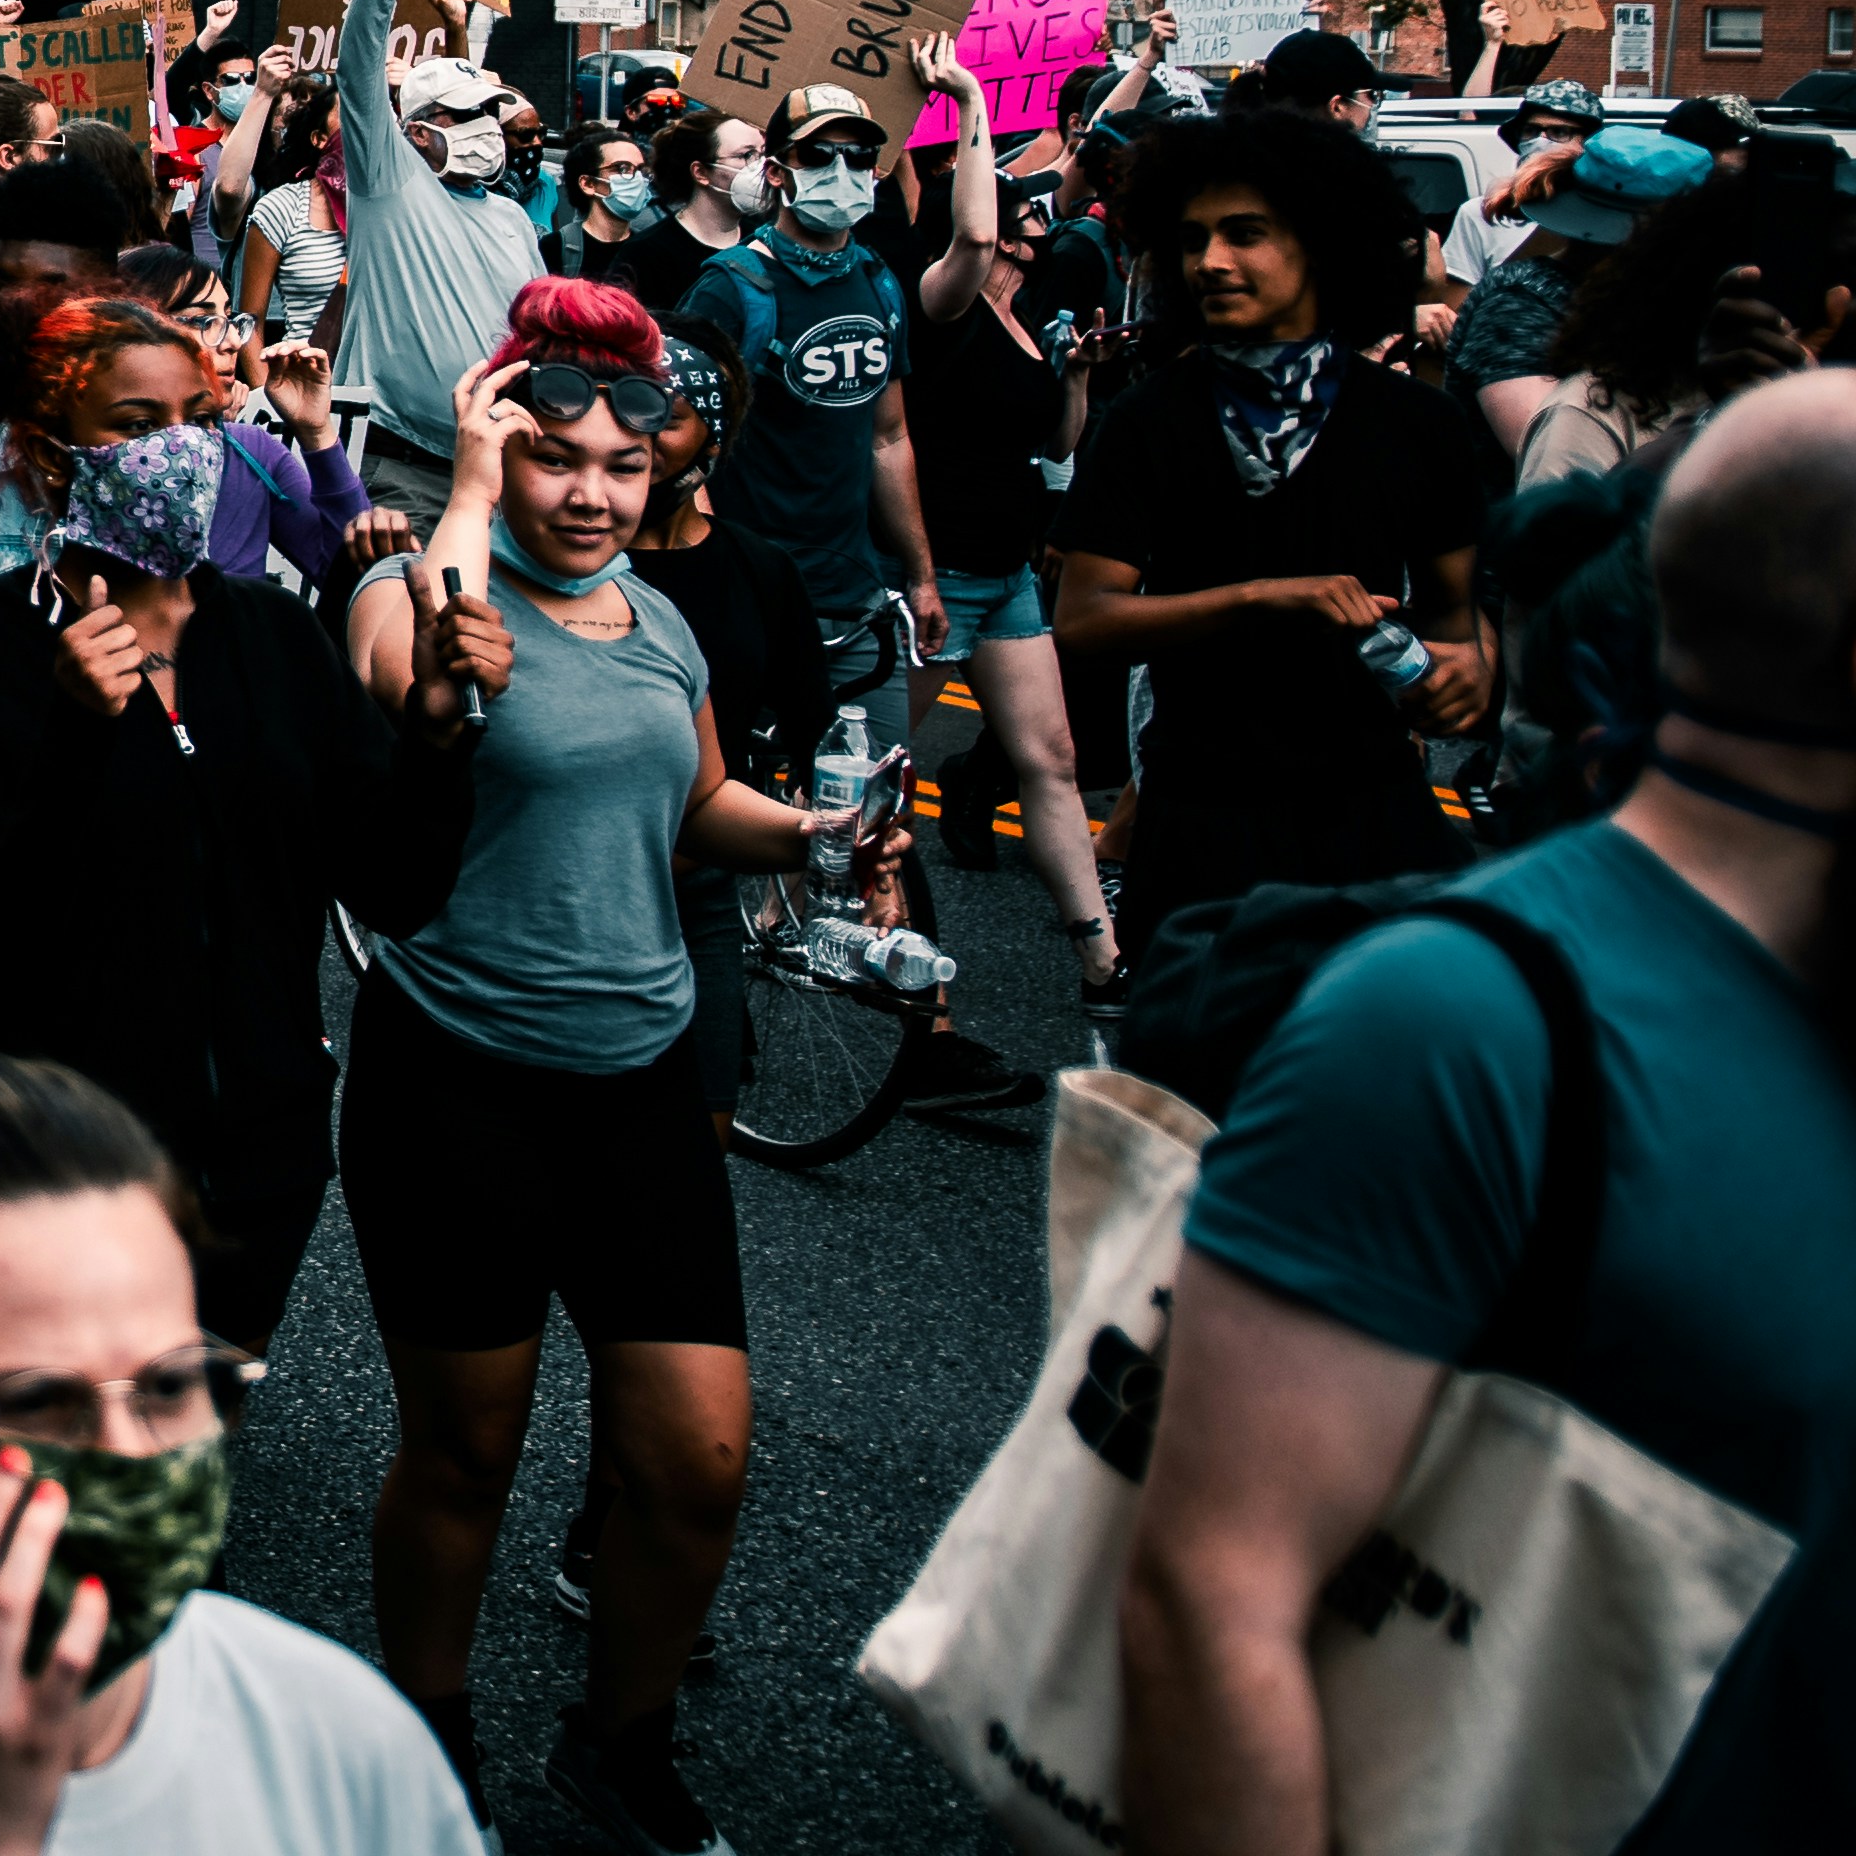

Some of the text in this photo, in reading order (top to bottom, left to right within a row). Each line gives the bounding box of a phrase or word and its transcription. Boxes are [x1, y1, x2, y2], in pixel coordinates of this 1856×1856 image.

[968, 6, 1100, 69] IVES
[801, 336, 888, 384] STS
[838, 378, 861, 390] PILS
